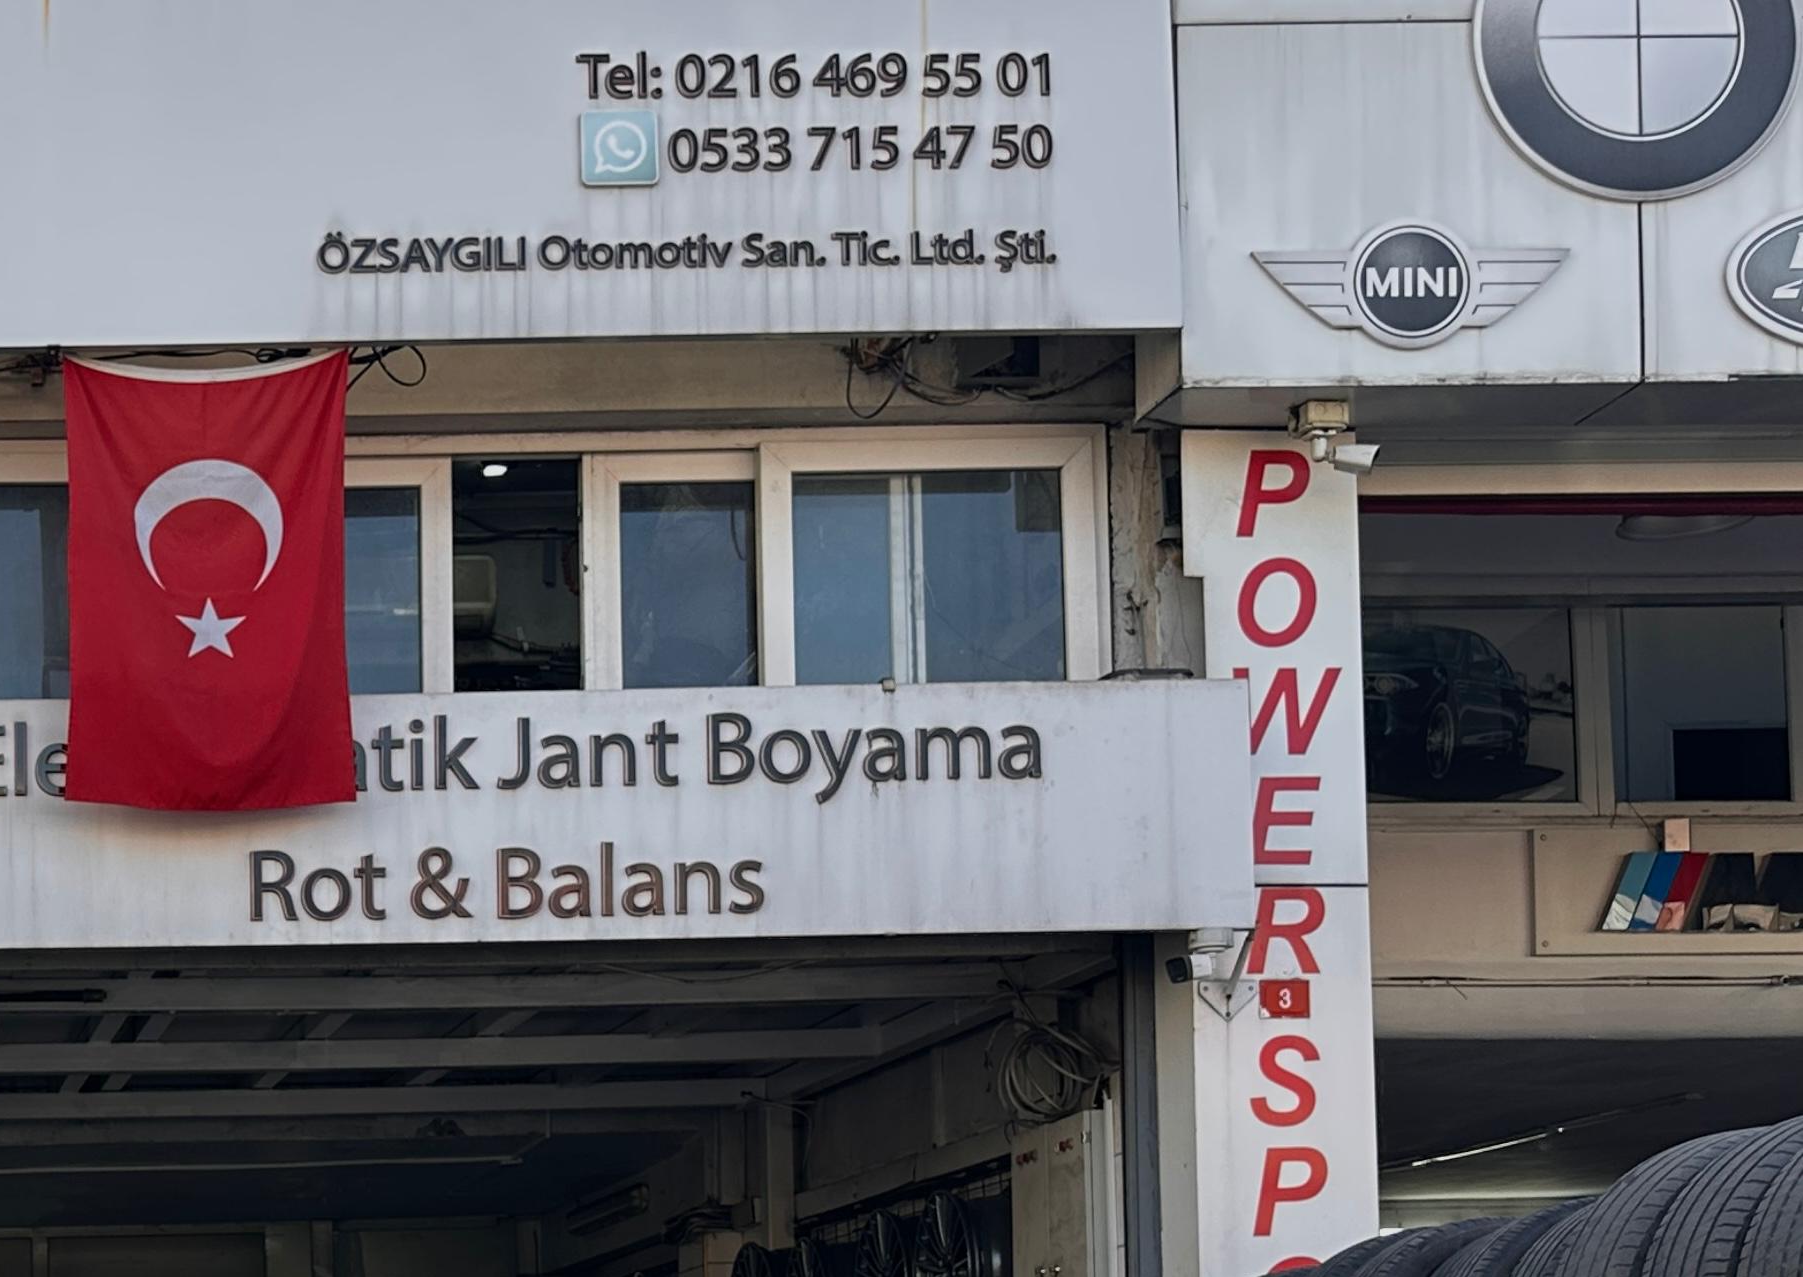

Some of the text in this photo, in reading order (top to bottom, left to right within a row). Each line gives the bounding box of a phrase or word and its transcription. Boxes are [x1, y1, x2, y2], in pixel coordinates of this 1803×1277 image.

[576, 51, 1050, 100] Tel: 0216 469 55 01
[667, 124, 1053, 173] 0533 715 47 50
[317, 229, 1057, 274] ÖZSAYGILI Otomotiv San. Tic. Ltd. Şti.
[1366, 266, 1458, 298] MINI
[497, 718, 679, 790] Jant
[706, 713, 1042, 805] Boyama
[249, 842, 764, 921] Rot & Balans
[1279, 988, 1291, 1009] 3
